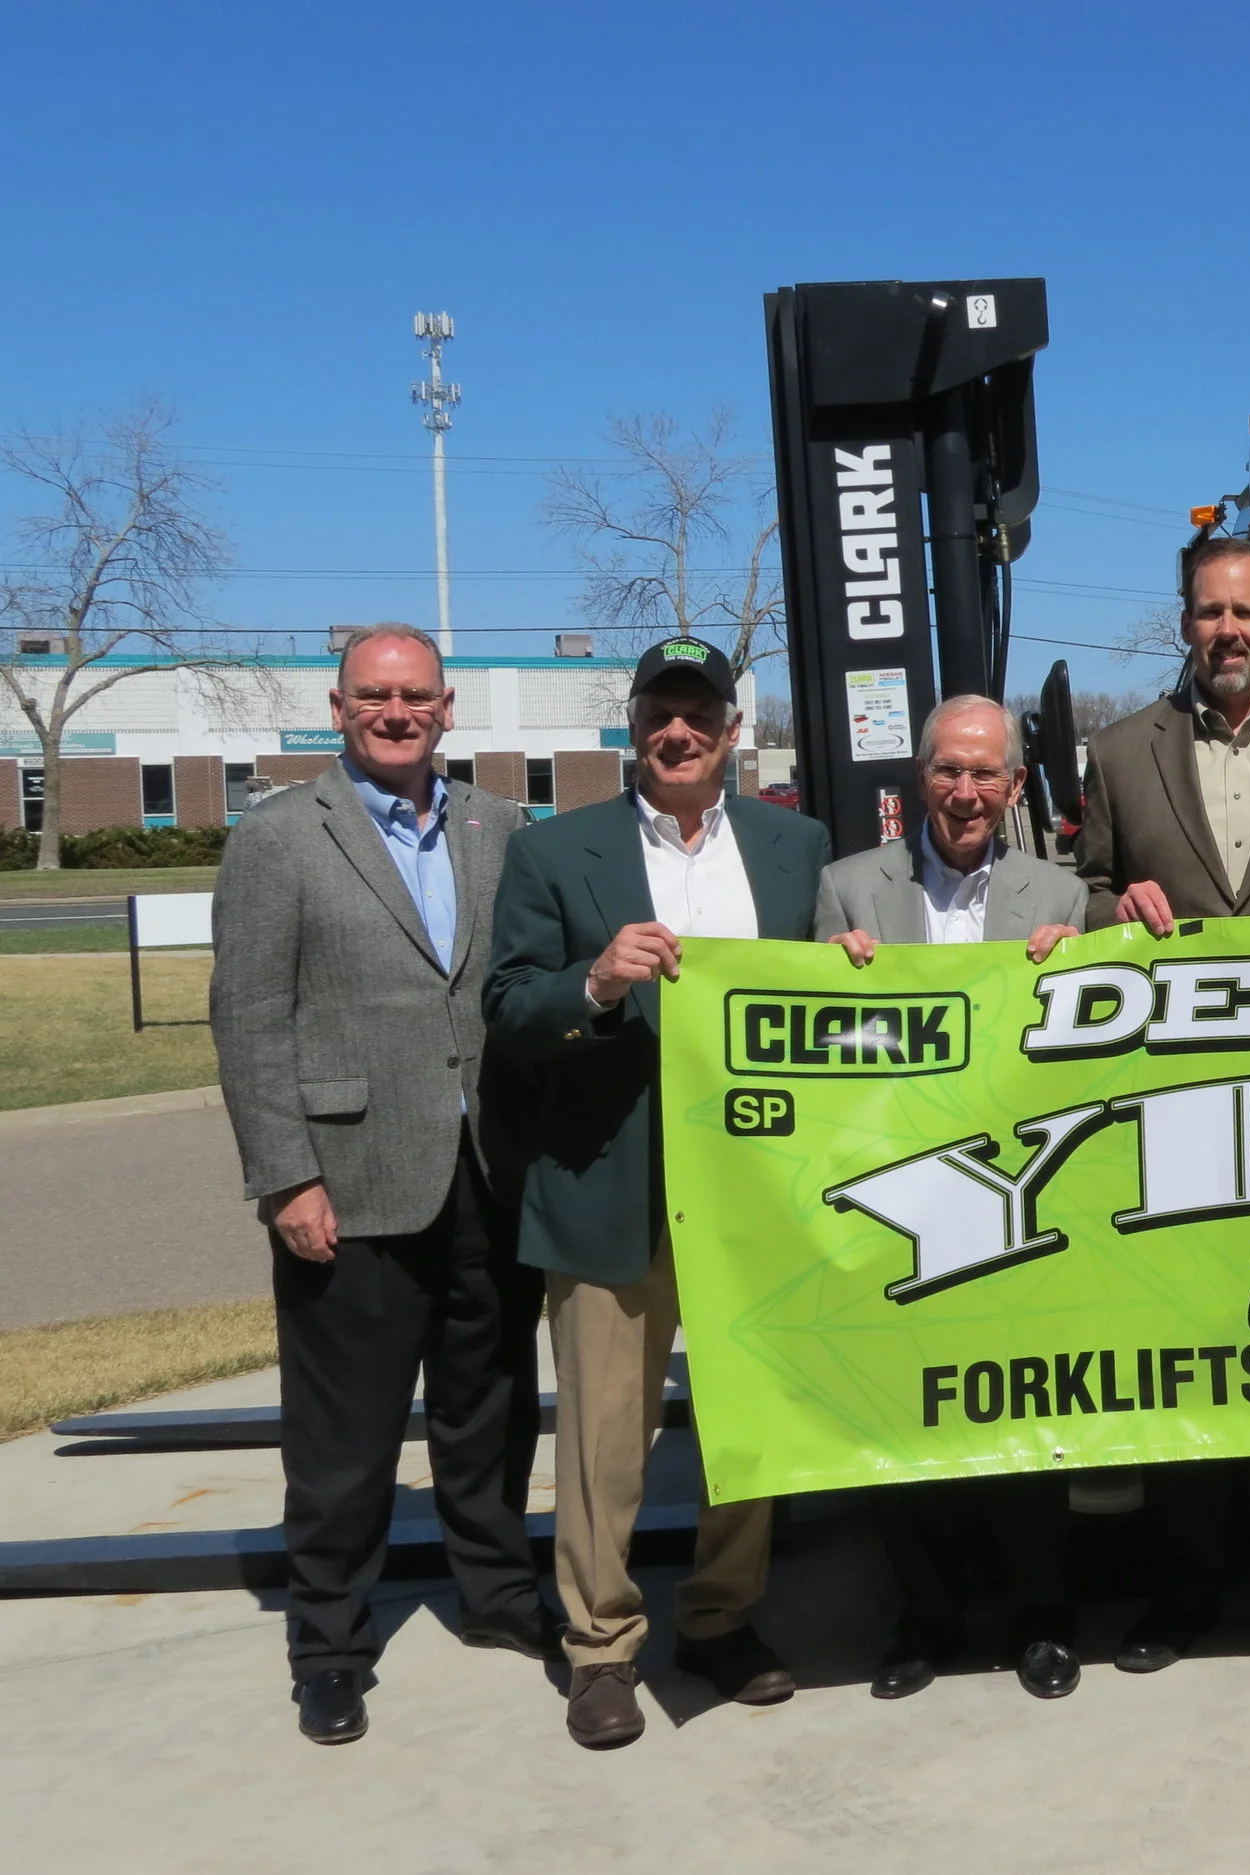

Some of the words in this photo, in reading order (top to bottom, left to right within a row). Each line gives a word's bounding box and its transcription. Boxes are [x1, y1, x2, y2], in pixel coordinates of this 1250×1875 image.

[834, 444, 905, 641] CLARK
[667, 646, 703, 658] CLARK
[745, 1004, 951, 1066] CLARK
[733, 1096, 788, 1129] SP
